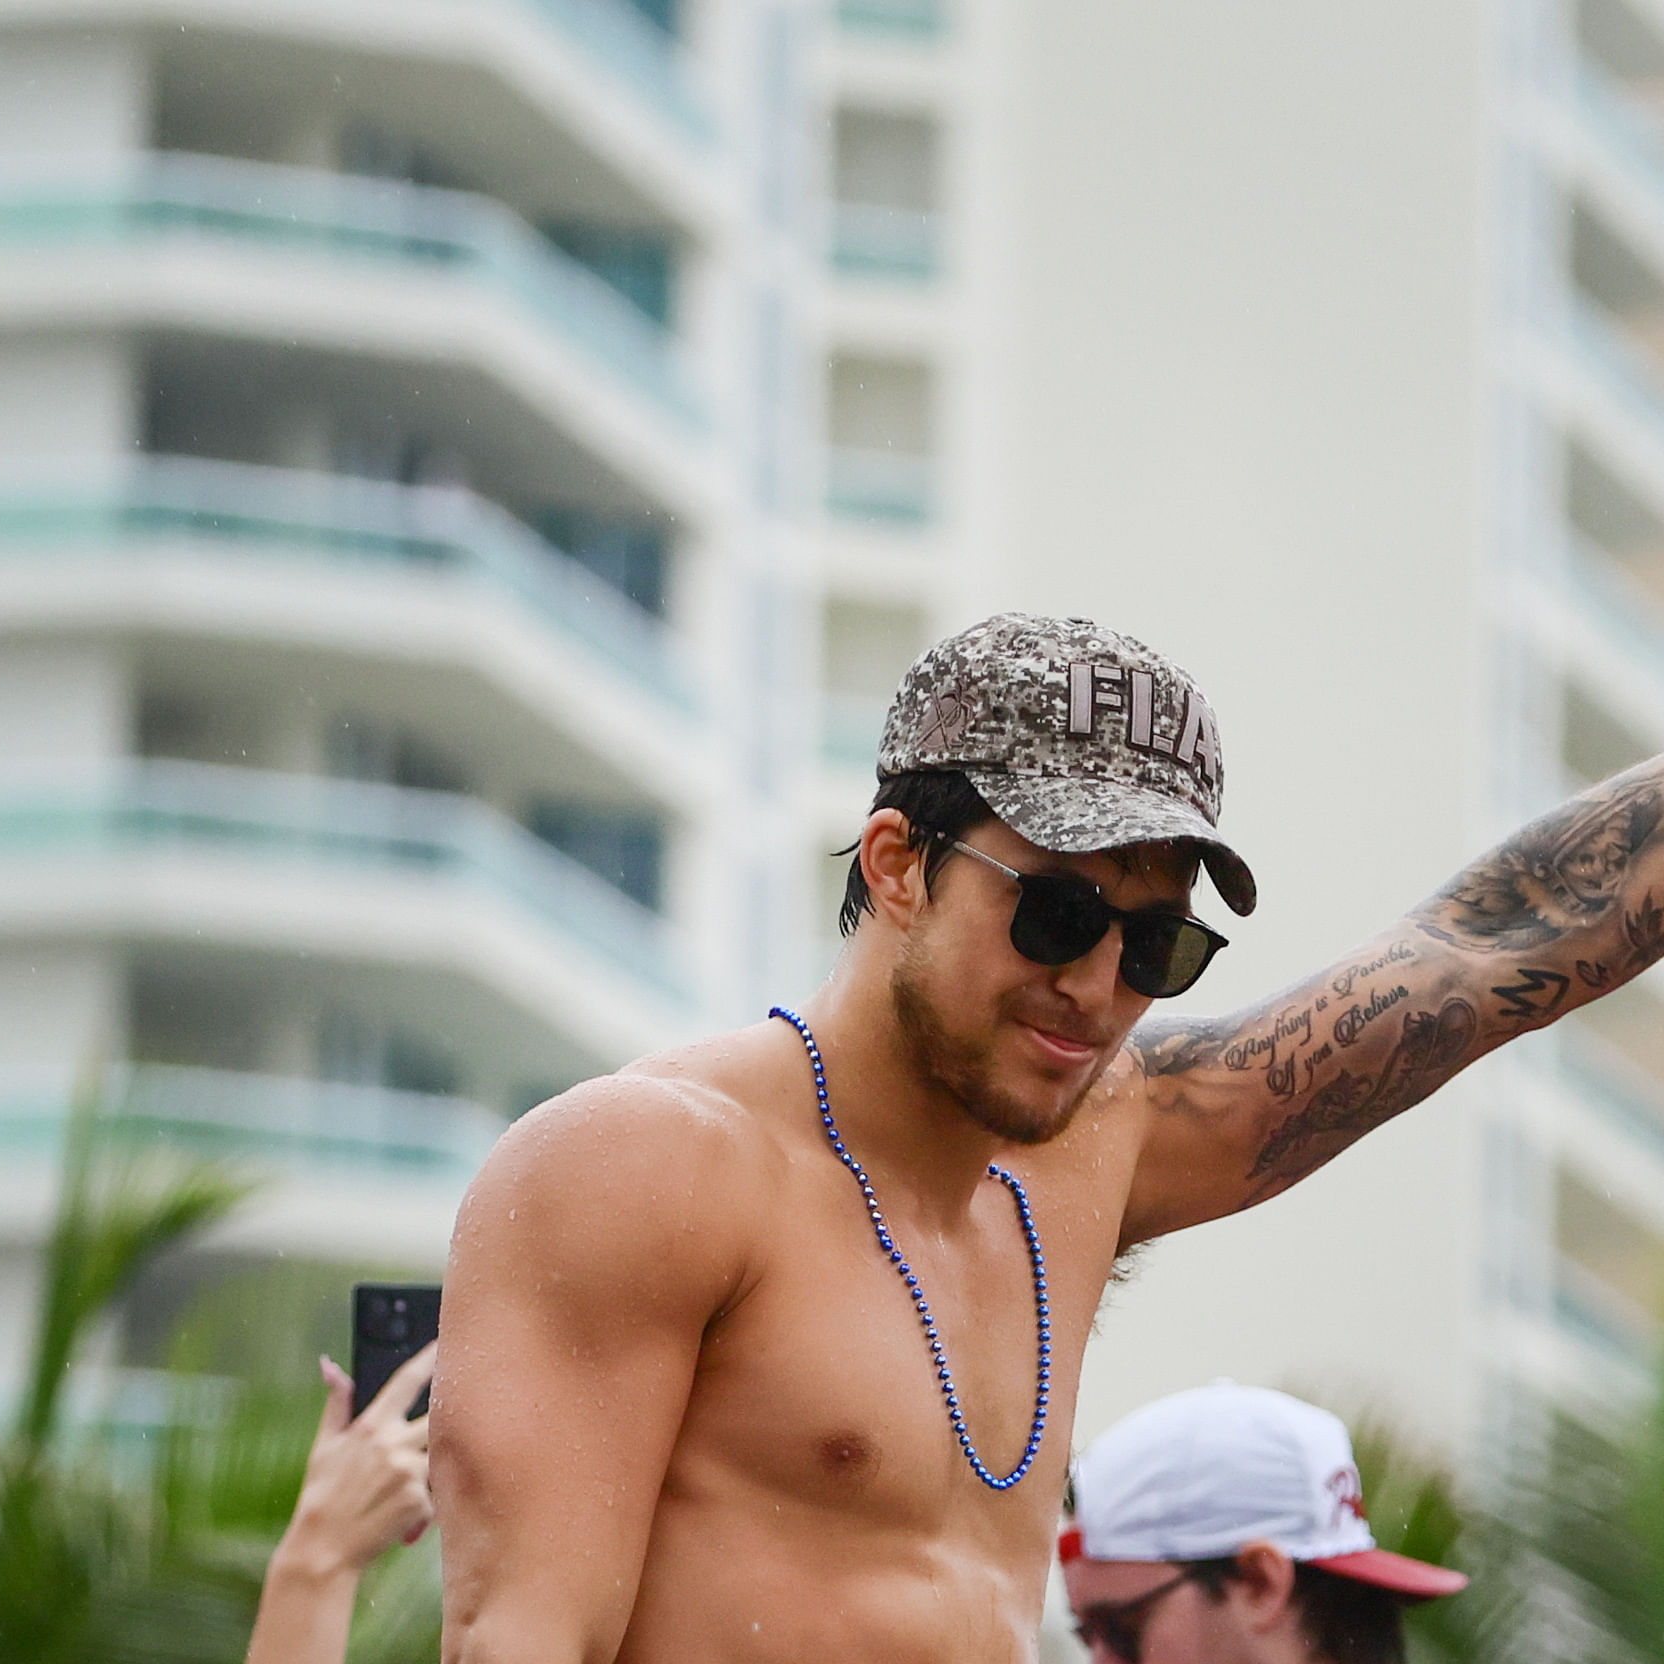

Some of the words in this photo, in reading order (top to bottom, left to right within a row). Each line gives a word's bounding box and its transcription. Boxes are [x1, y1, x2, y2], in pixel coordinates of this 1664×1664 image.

[1068, 661, 1217, 790] FLA
[1315, 996, 1329, 1013] is
[1334, 985, 1410, 1049] Believe
